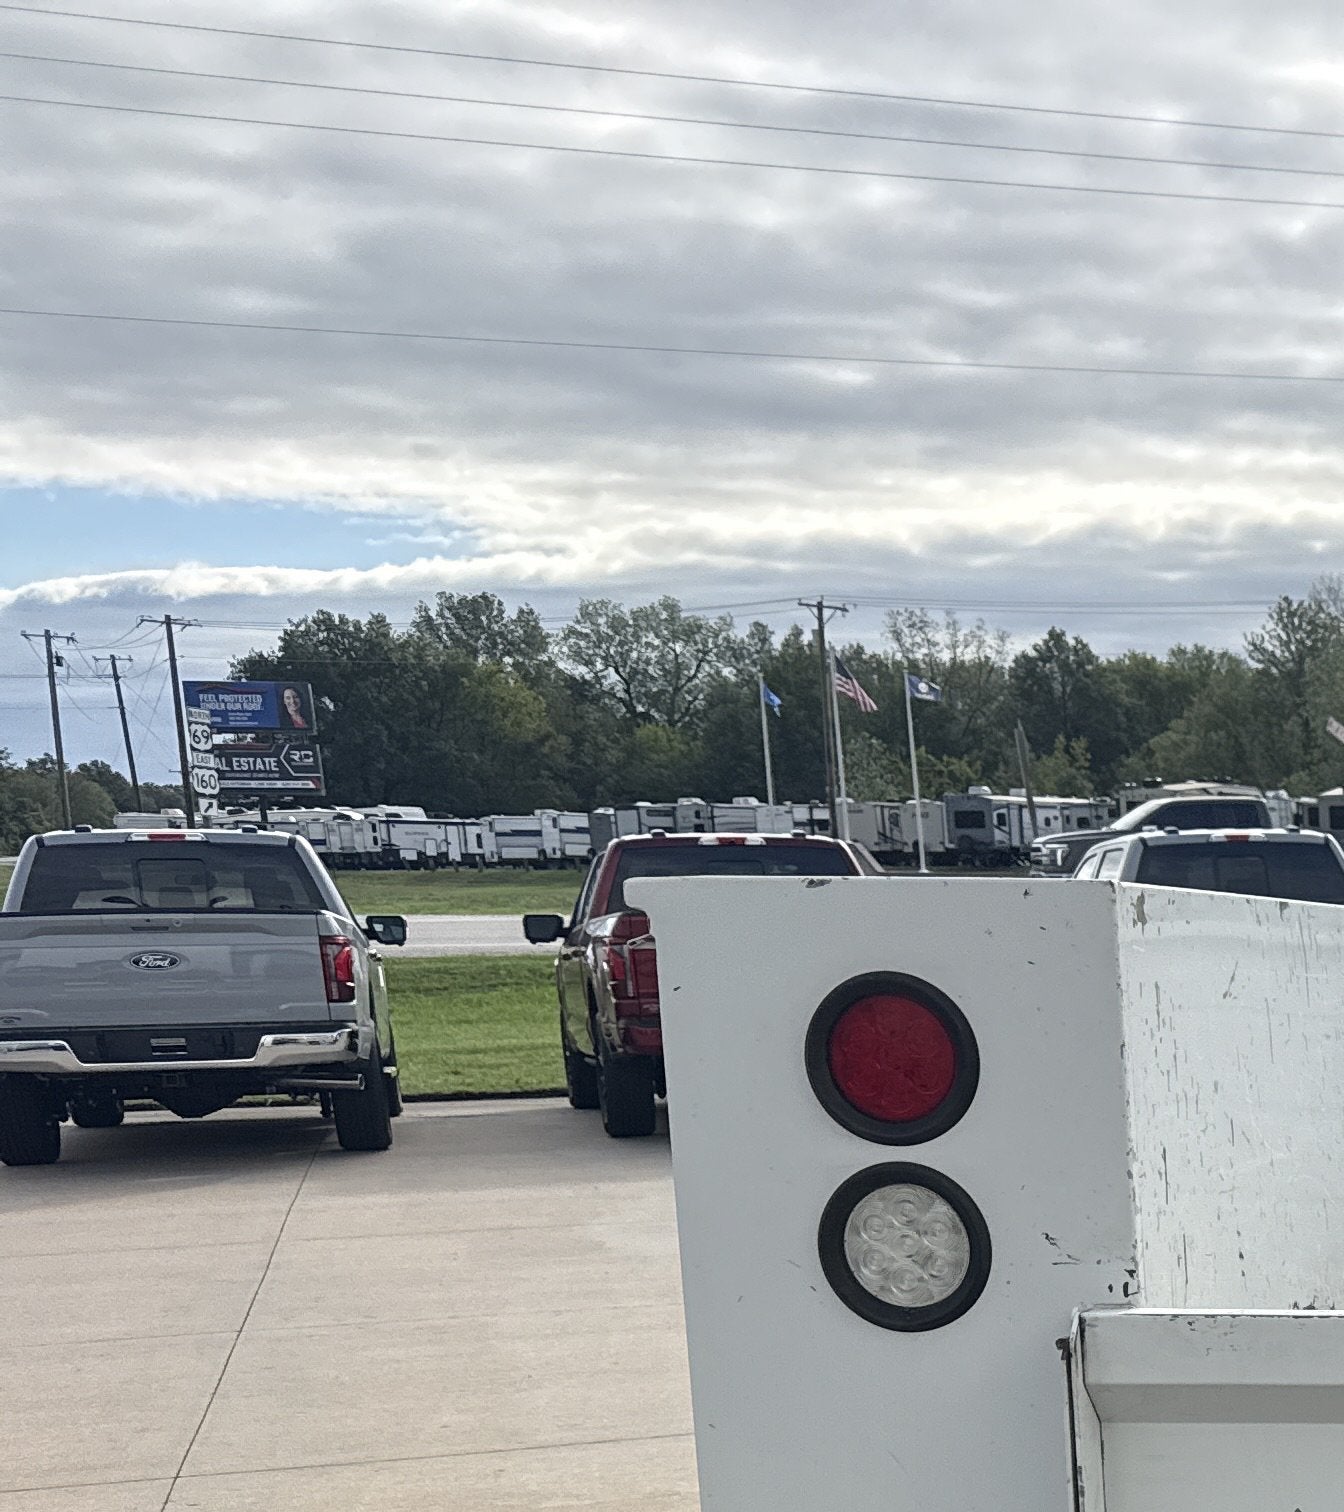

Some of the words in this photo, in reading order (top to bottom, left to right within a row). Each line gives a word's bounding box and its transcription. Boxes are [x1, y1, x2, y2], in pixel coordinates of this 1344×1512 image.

[199, 693, 216, 702] FEEL
[219, 694, 262, 703] PROTECTED
[192, 729, 209, 745] 69
[195, 753, 211, 764] EAST
[214, 756, 231, 771] AL
[232, 757, 280, 771] ESTATE
[194, 772, 217, 790] 160
